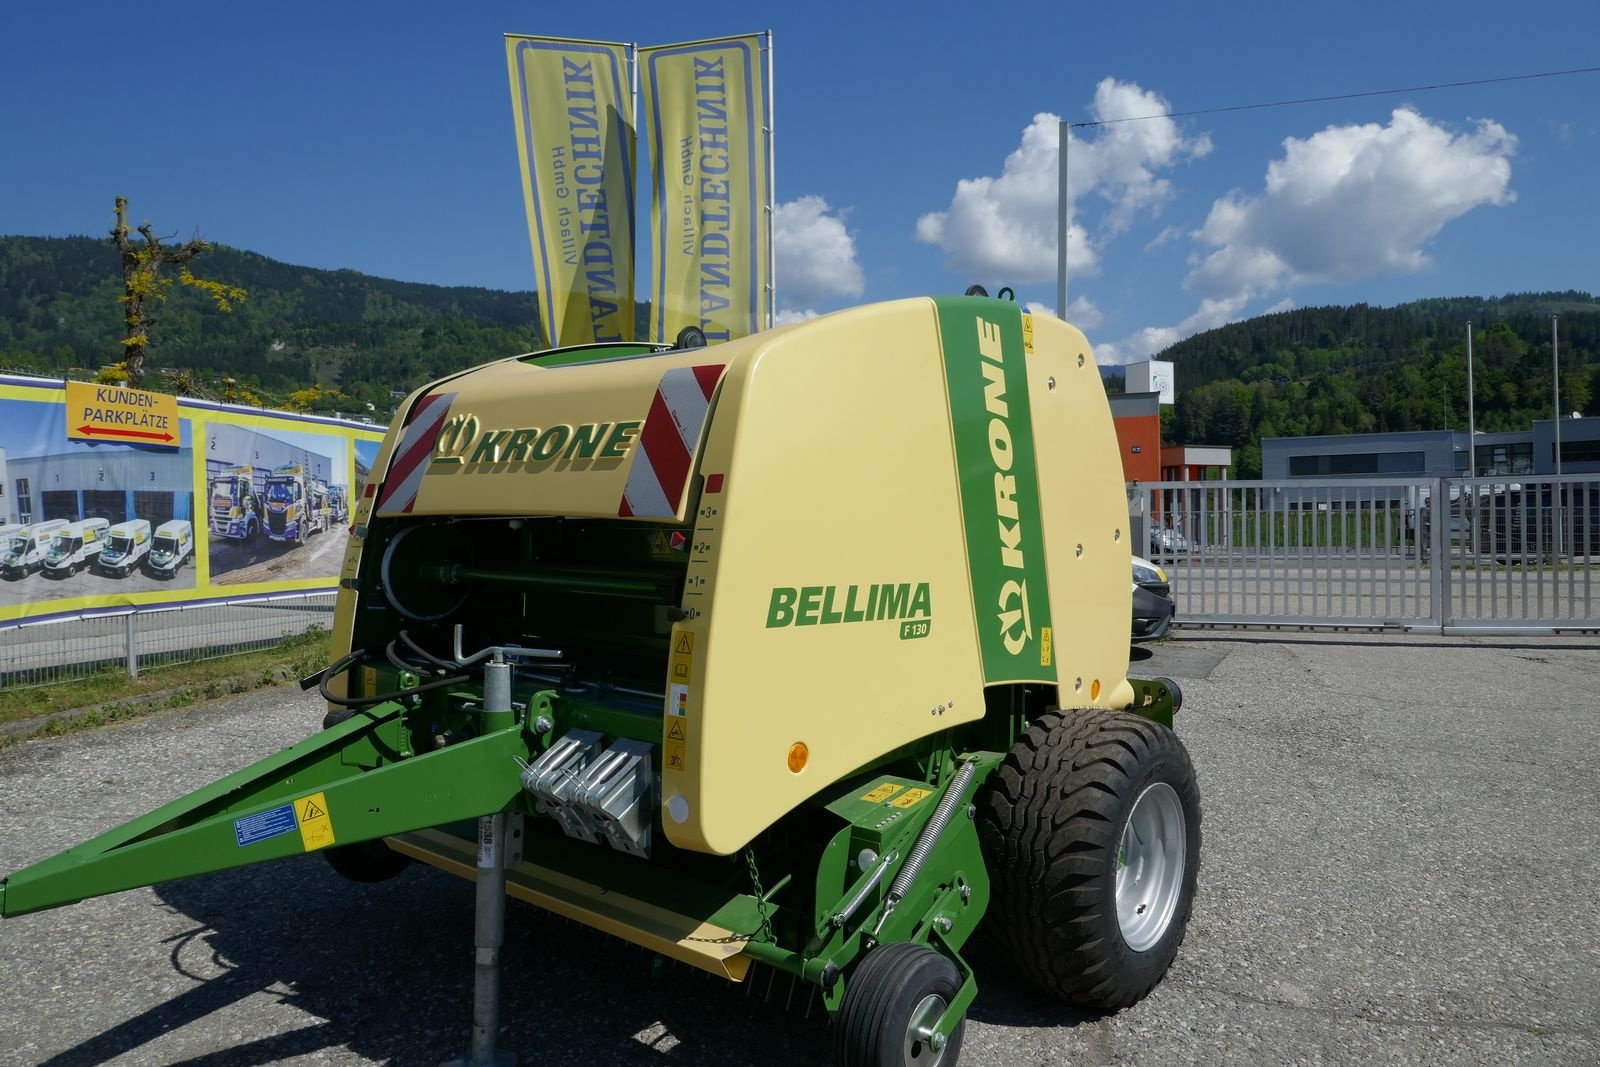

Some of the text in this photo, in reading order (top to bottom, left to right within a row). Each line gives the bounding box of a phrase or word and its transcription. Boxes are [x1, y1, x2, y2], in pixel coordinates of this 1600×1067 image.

[96, 387, 158, 406] KUNDEN-
[83, 408, 168, 429] PARKPLÄTZE
[471, 420, 645, 463] KRONE
[975, 316, 1024, 569] KRONE
[765, 582, 932, 629] BELLIMA
[904, 623, 927, 636] F 130
